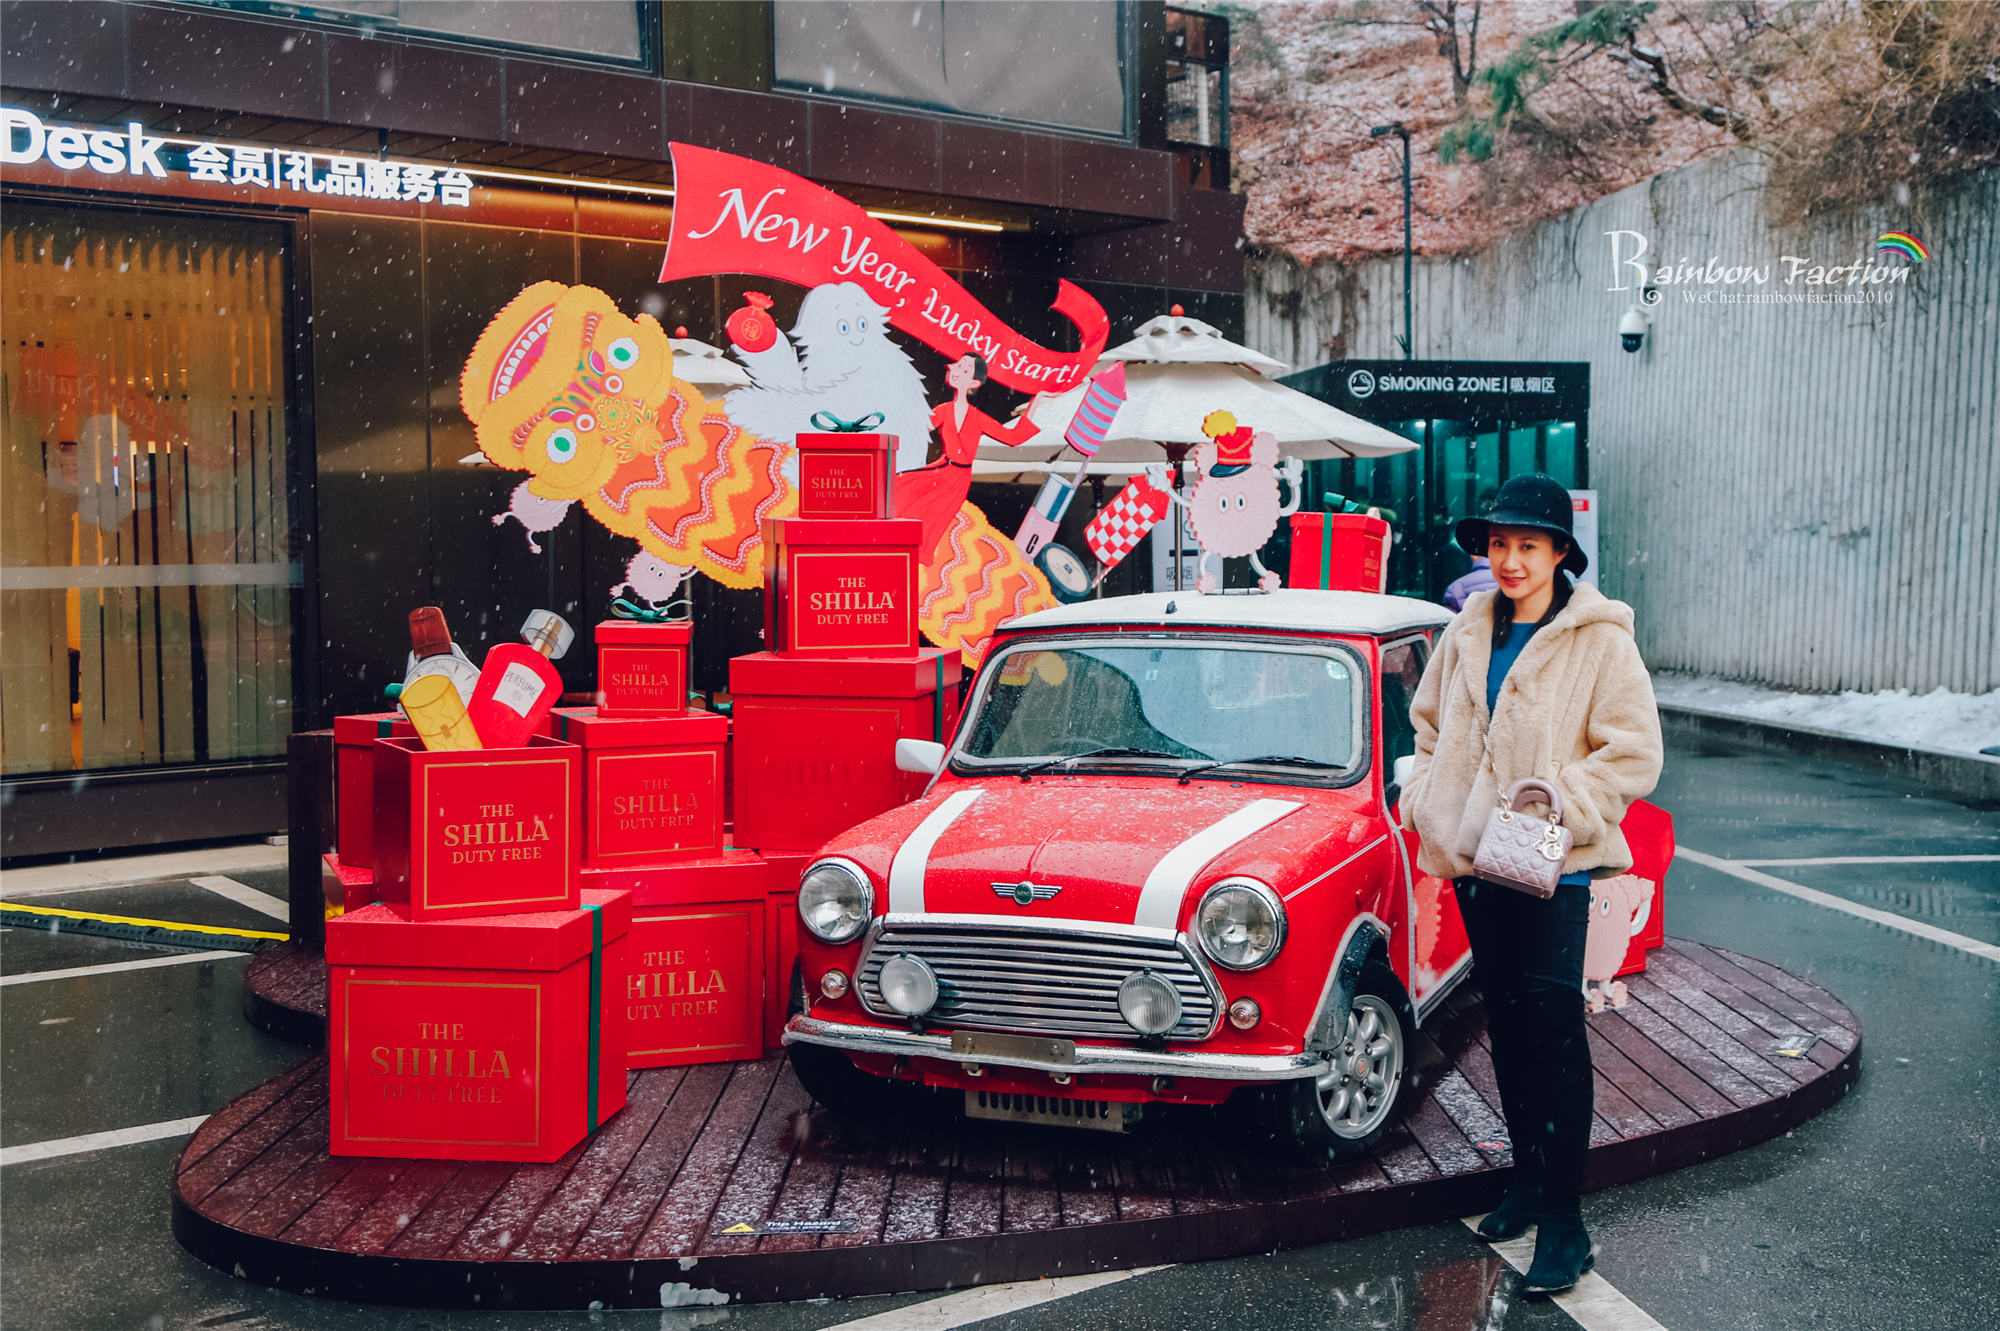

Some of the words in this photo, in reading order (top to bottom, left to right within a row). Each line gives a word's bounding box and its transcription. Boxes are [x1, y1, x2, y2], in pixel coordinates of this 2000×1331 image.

[0, 108, 168, 178] Desk
[688, 188, 829, 253] New
[833, 225, 916, 308] Year,
[922, 288, 1001, 364] Lucky
[1001, 348, 1080, 384] Start!
[1379, 376, 1454, 392] SMOKING
[1457, 377, 1502, 392] ZONE
[1510, 377, 1556, 393] 吸烟区
[811, 477, 863, 490] SHILLA
[1026, 533, 1039, 554] C
[838, 577, 866, 588] THE
[810, 592, 895, 610] SHILLA
[817, 614, 852, 625] DUTY
[856, 613, 889, 624] FREE
[503, 671, 539, 700] PERFUME
[612, 673, 669, 686] SHILLA
[642, 779, 671, 790] THE
[480, 804, 514, 818] THE
[613, 793, 699, 815] SHILLA
[620, 817, 656, 830] DUTY
[661, 815, 694, 827] FREE
[444, 821, 550, 847] SHILLA
[452, 850, 496, 864] DUTY
[502, 847, 542, 861] FREE
[644, 950, 685, 967] THE
[627, 969, 727, 999] HILLA
[627, 1004, 662, 1021] UTY
[671, 1000, 718, 1017] FREE
[418, 1023, 464, 1041] THE
[371, 1046, 512, 1079] SHILLA
[383, 1084, 438, 1101] DUTY
[448, 1086, 502, 1104] FREE
